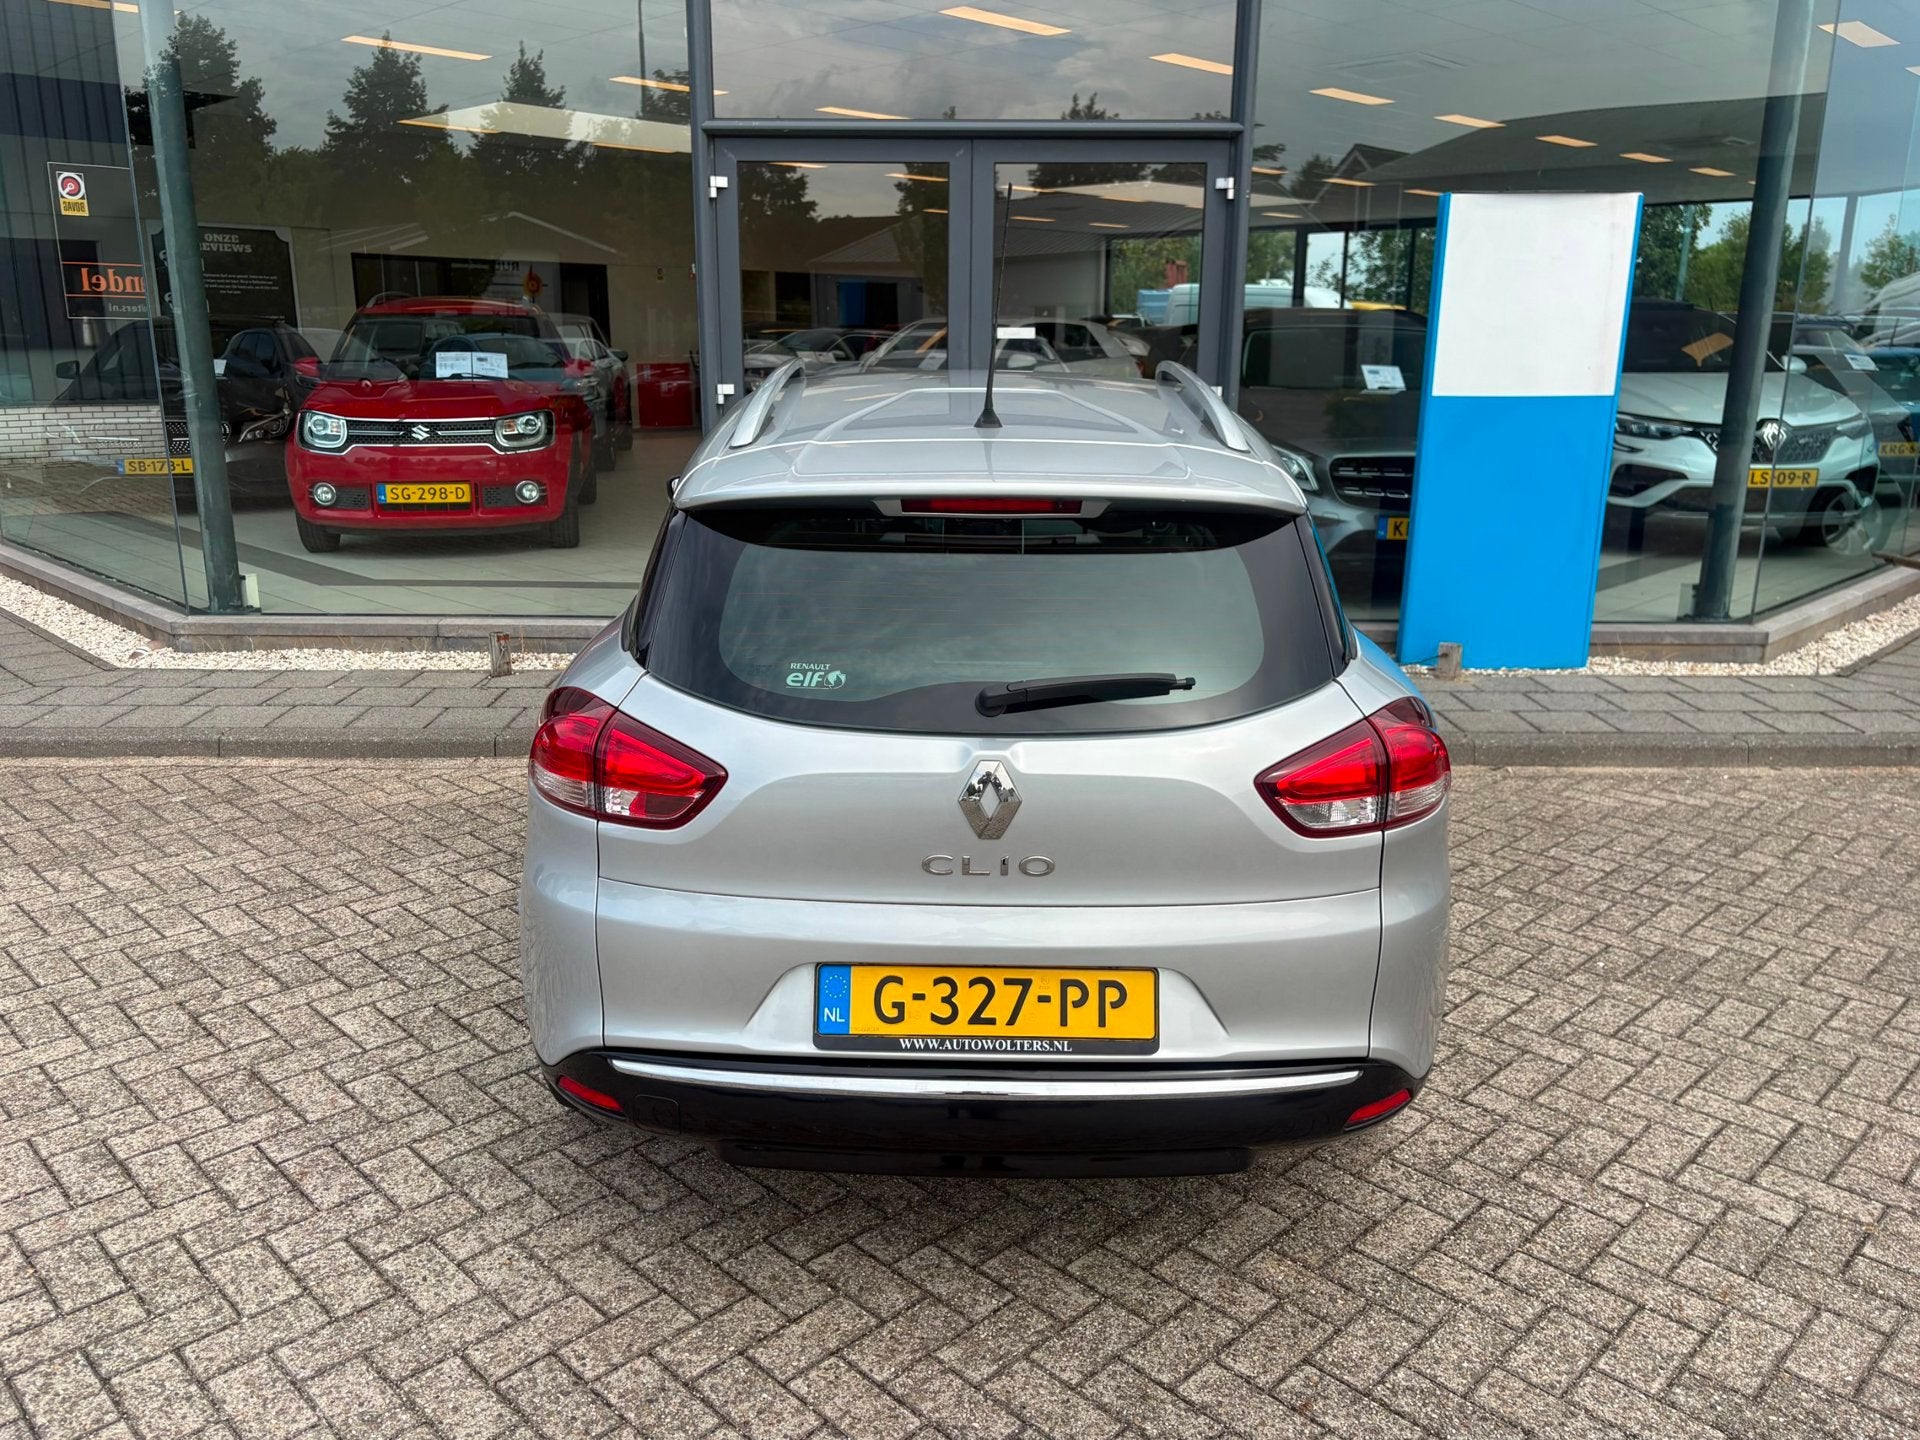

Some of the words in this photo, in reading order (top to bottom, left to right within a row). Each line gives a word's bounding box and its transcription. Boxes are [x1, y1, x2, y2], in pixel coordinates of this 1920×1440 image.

[204, 233, 240, 243] ONZE
[390, 487, 465, 500] SG-298-D
[790, 662, 831, 670] RENAULT
[786, 671, 825, 687] elf
[921, 854, 1056, 877] CLIO
[873, 975, 1128, 1028] G-327-PP
[824, 1007, 845, 1023] NL
[899, 1038, 1073, 1052] WWW.AUTOWOLTERS.NL
